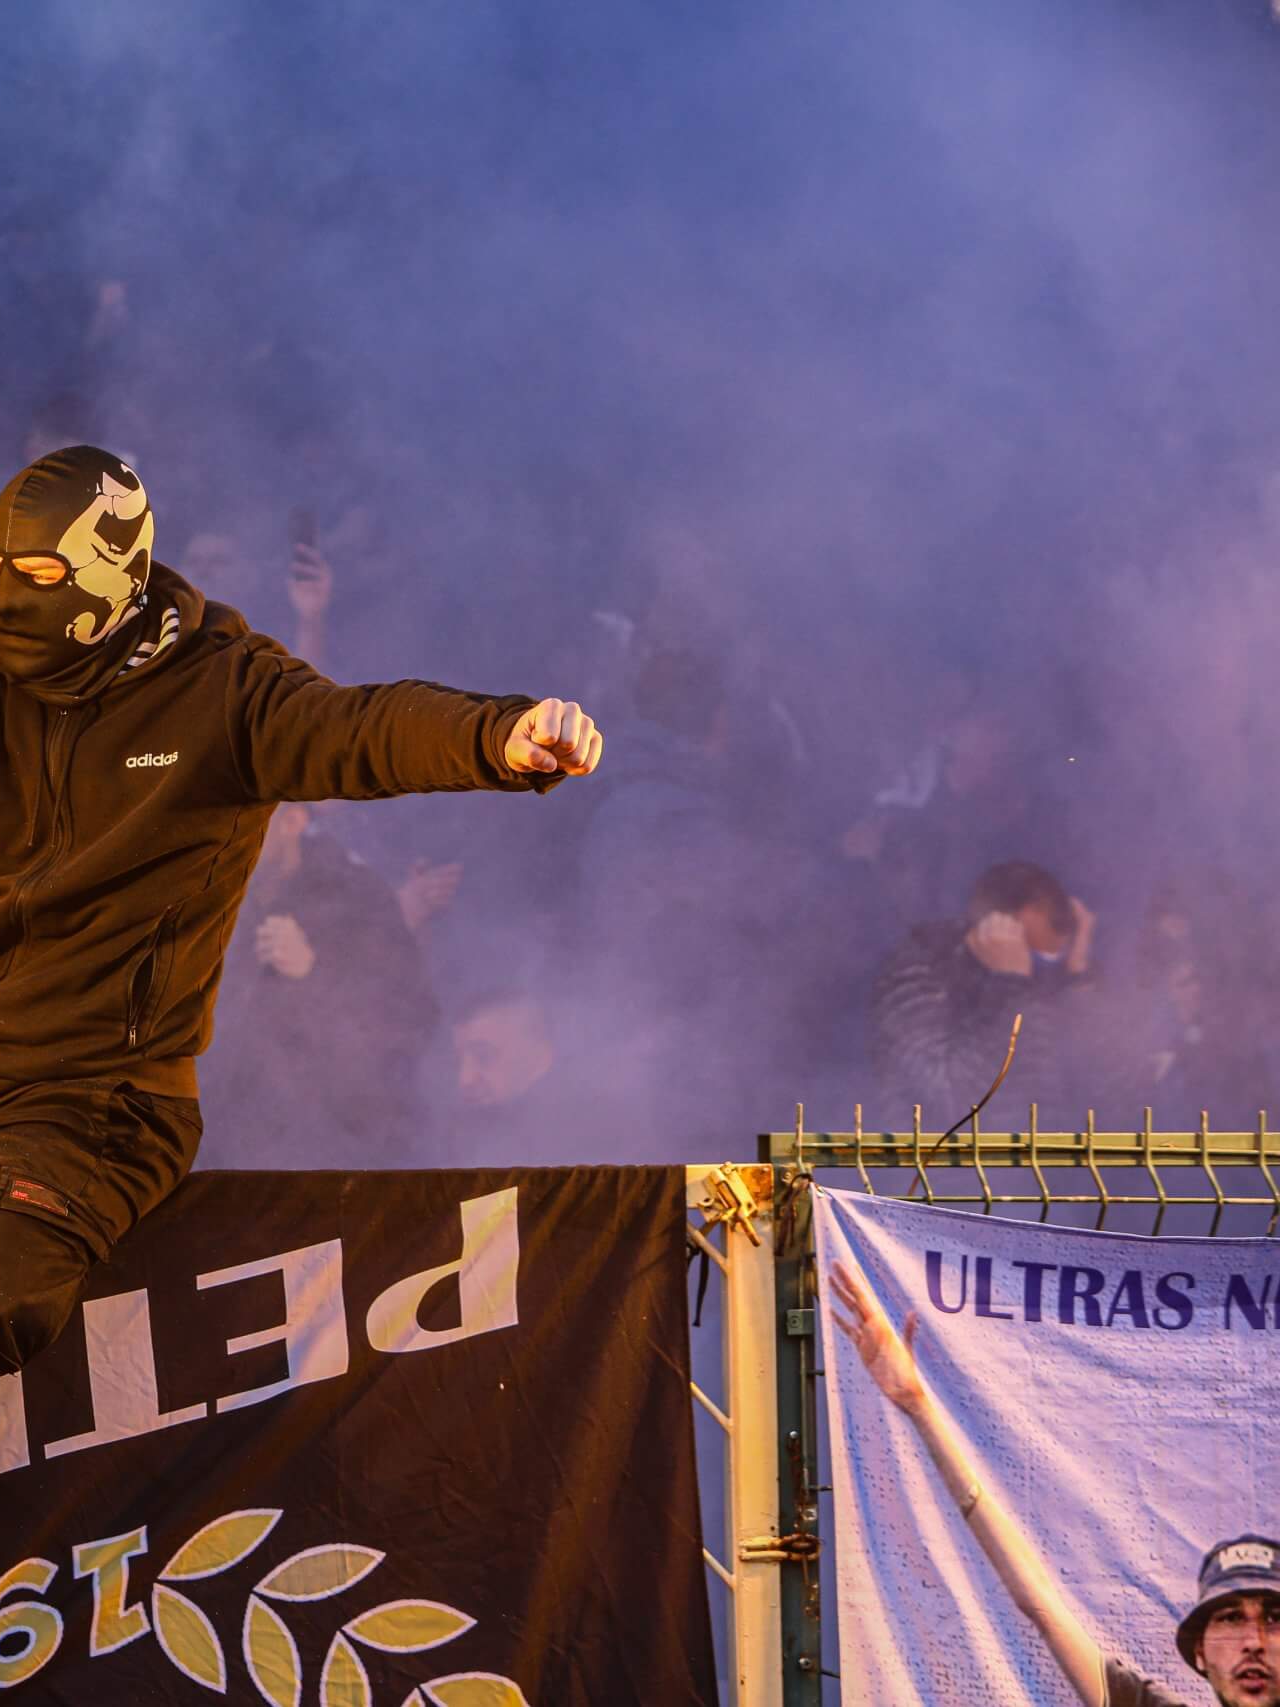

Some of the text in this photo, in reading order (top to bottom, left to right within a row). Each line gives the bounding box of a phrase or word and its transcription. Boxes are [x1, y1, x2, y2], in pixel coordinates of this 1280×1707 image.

[126, 752, 179, 768] adidas
[925, 1250, 1280, 1331] ULTRAS N
